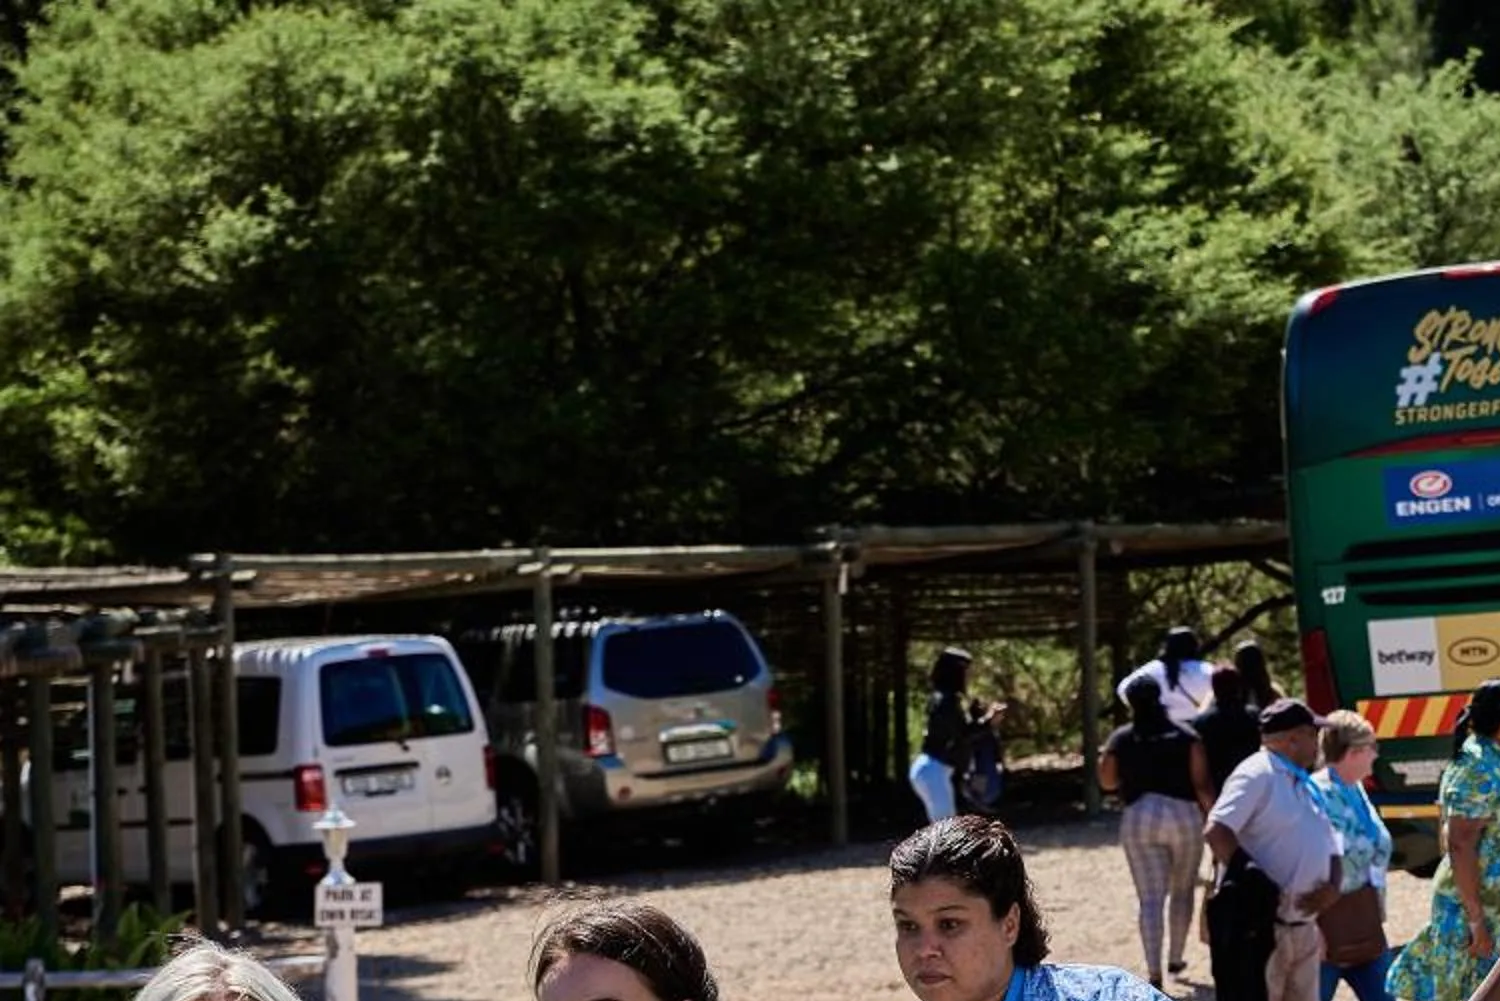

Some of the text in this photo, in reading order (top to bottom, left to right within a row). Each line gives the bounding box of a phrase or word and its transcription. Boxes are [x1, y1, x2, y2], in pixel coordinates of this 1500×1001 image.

[1396, 496, 1471, 517] ENGEN
[1377, 650, 1435, 666] betway
[1460, 645, 1489, 657] MTN
